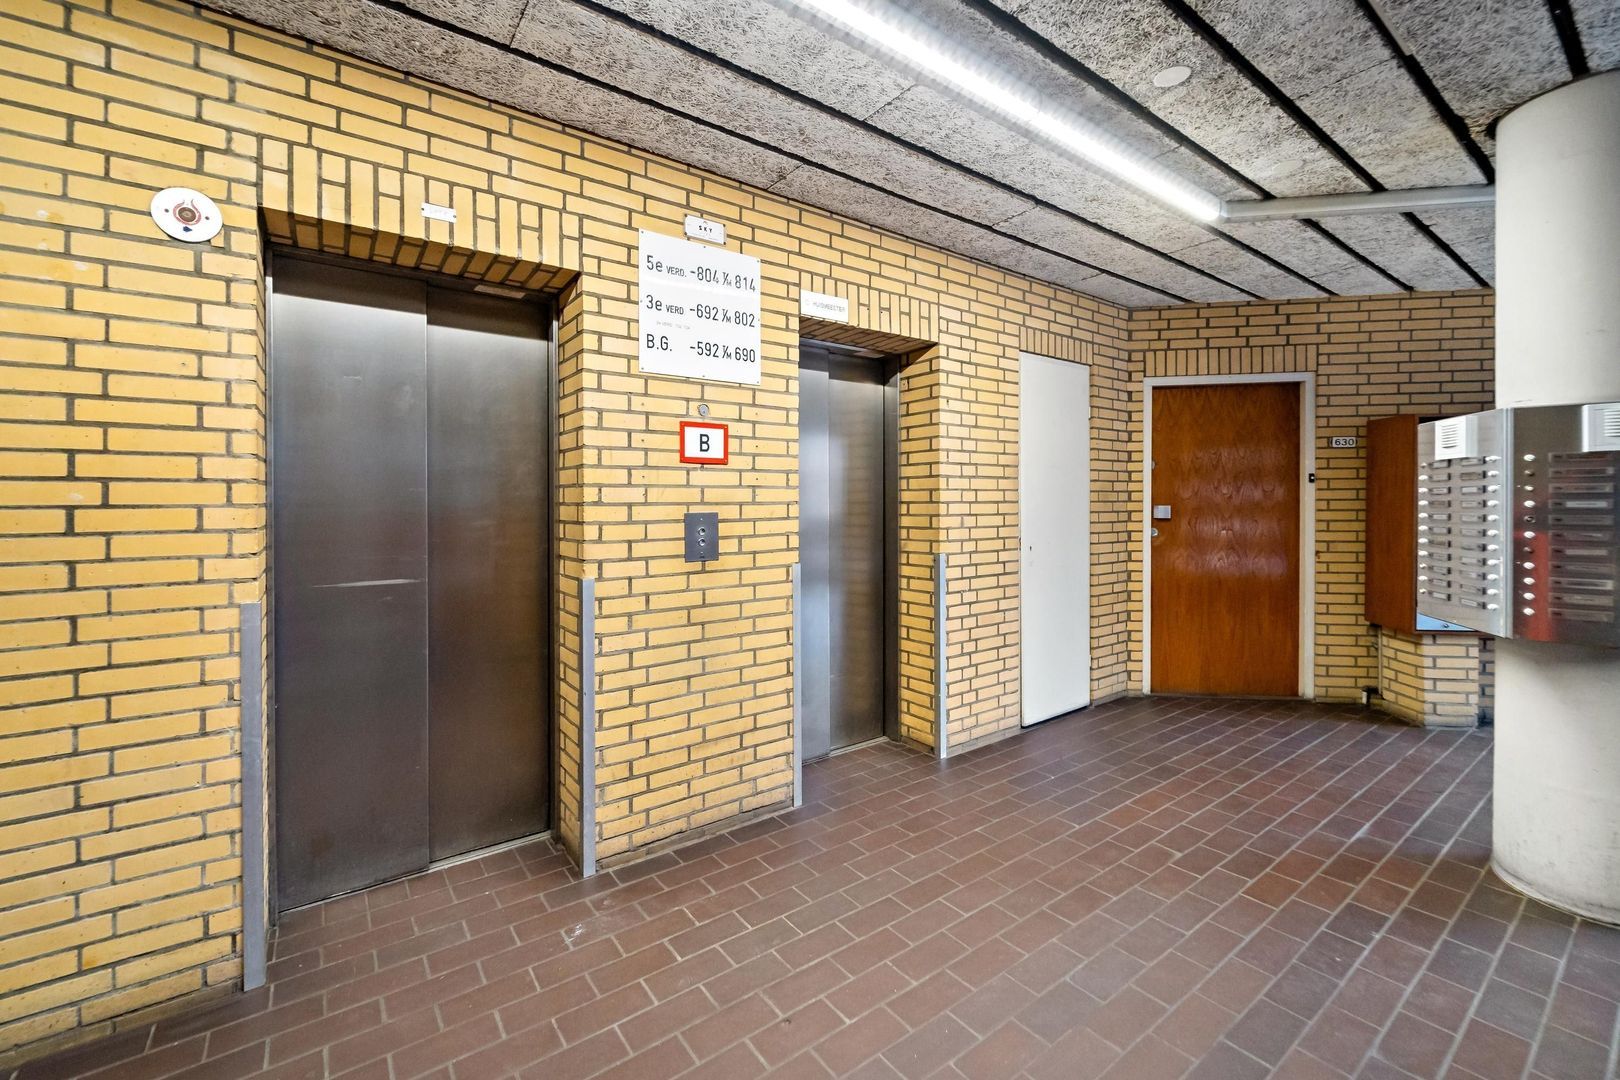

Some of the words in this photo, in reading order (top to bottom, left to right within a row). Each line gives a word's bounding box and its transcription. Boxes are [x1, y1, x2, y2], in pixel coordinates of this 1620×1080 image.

[646, 254, 663, 272] 5e
[666, 265, 687, 277] VERD.
[735, 274, 756, 292] 814
[646, 294, 662, 311] 3e
[665, 304, 684, 315] VERD
[734, 310, 755, 328] 802
[646, 333, 672, 352] B.G.
[734, 346, 756, 363] 690
[699, 433, 710, 452] B
[1334, 438, 1355, 446] 630
